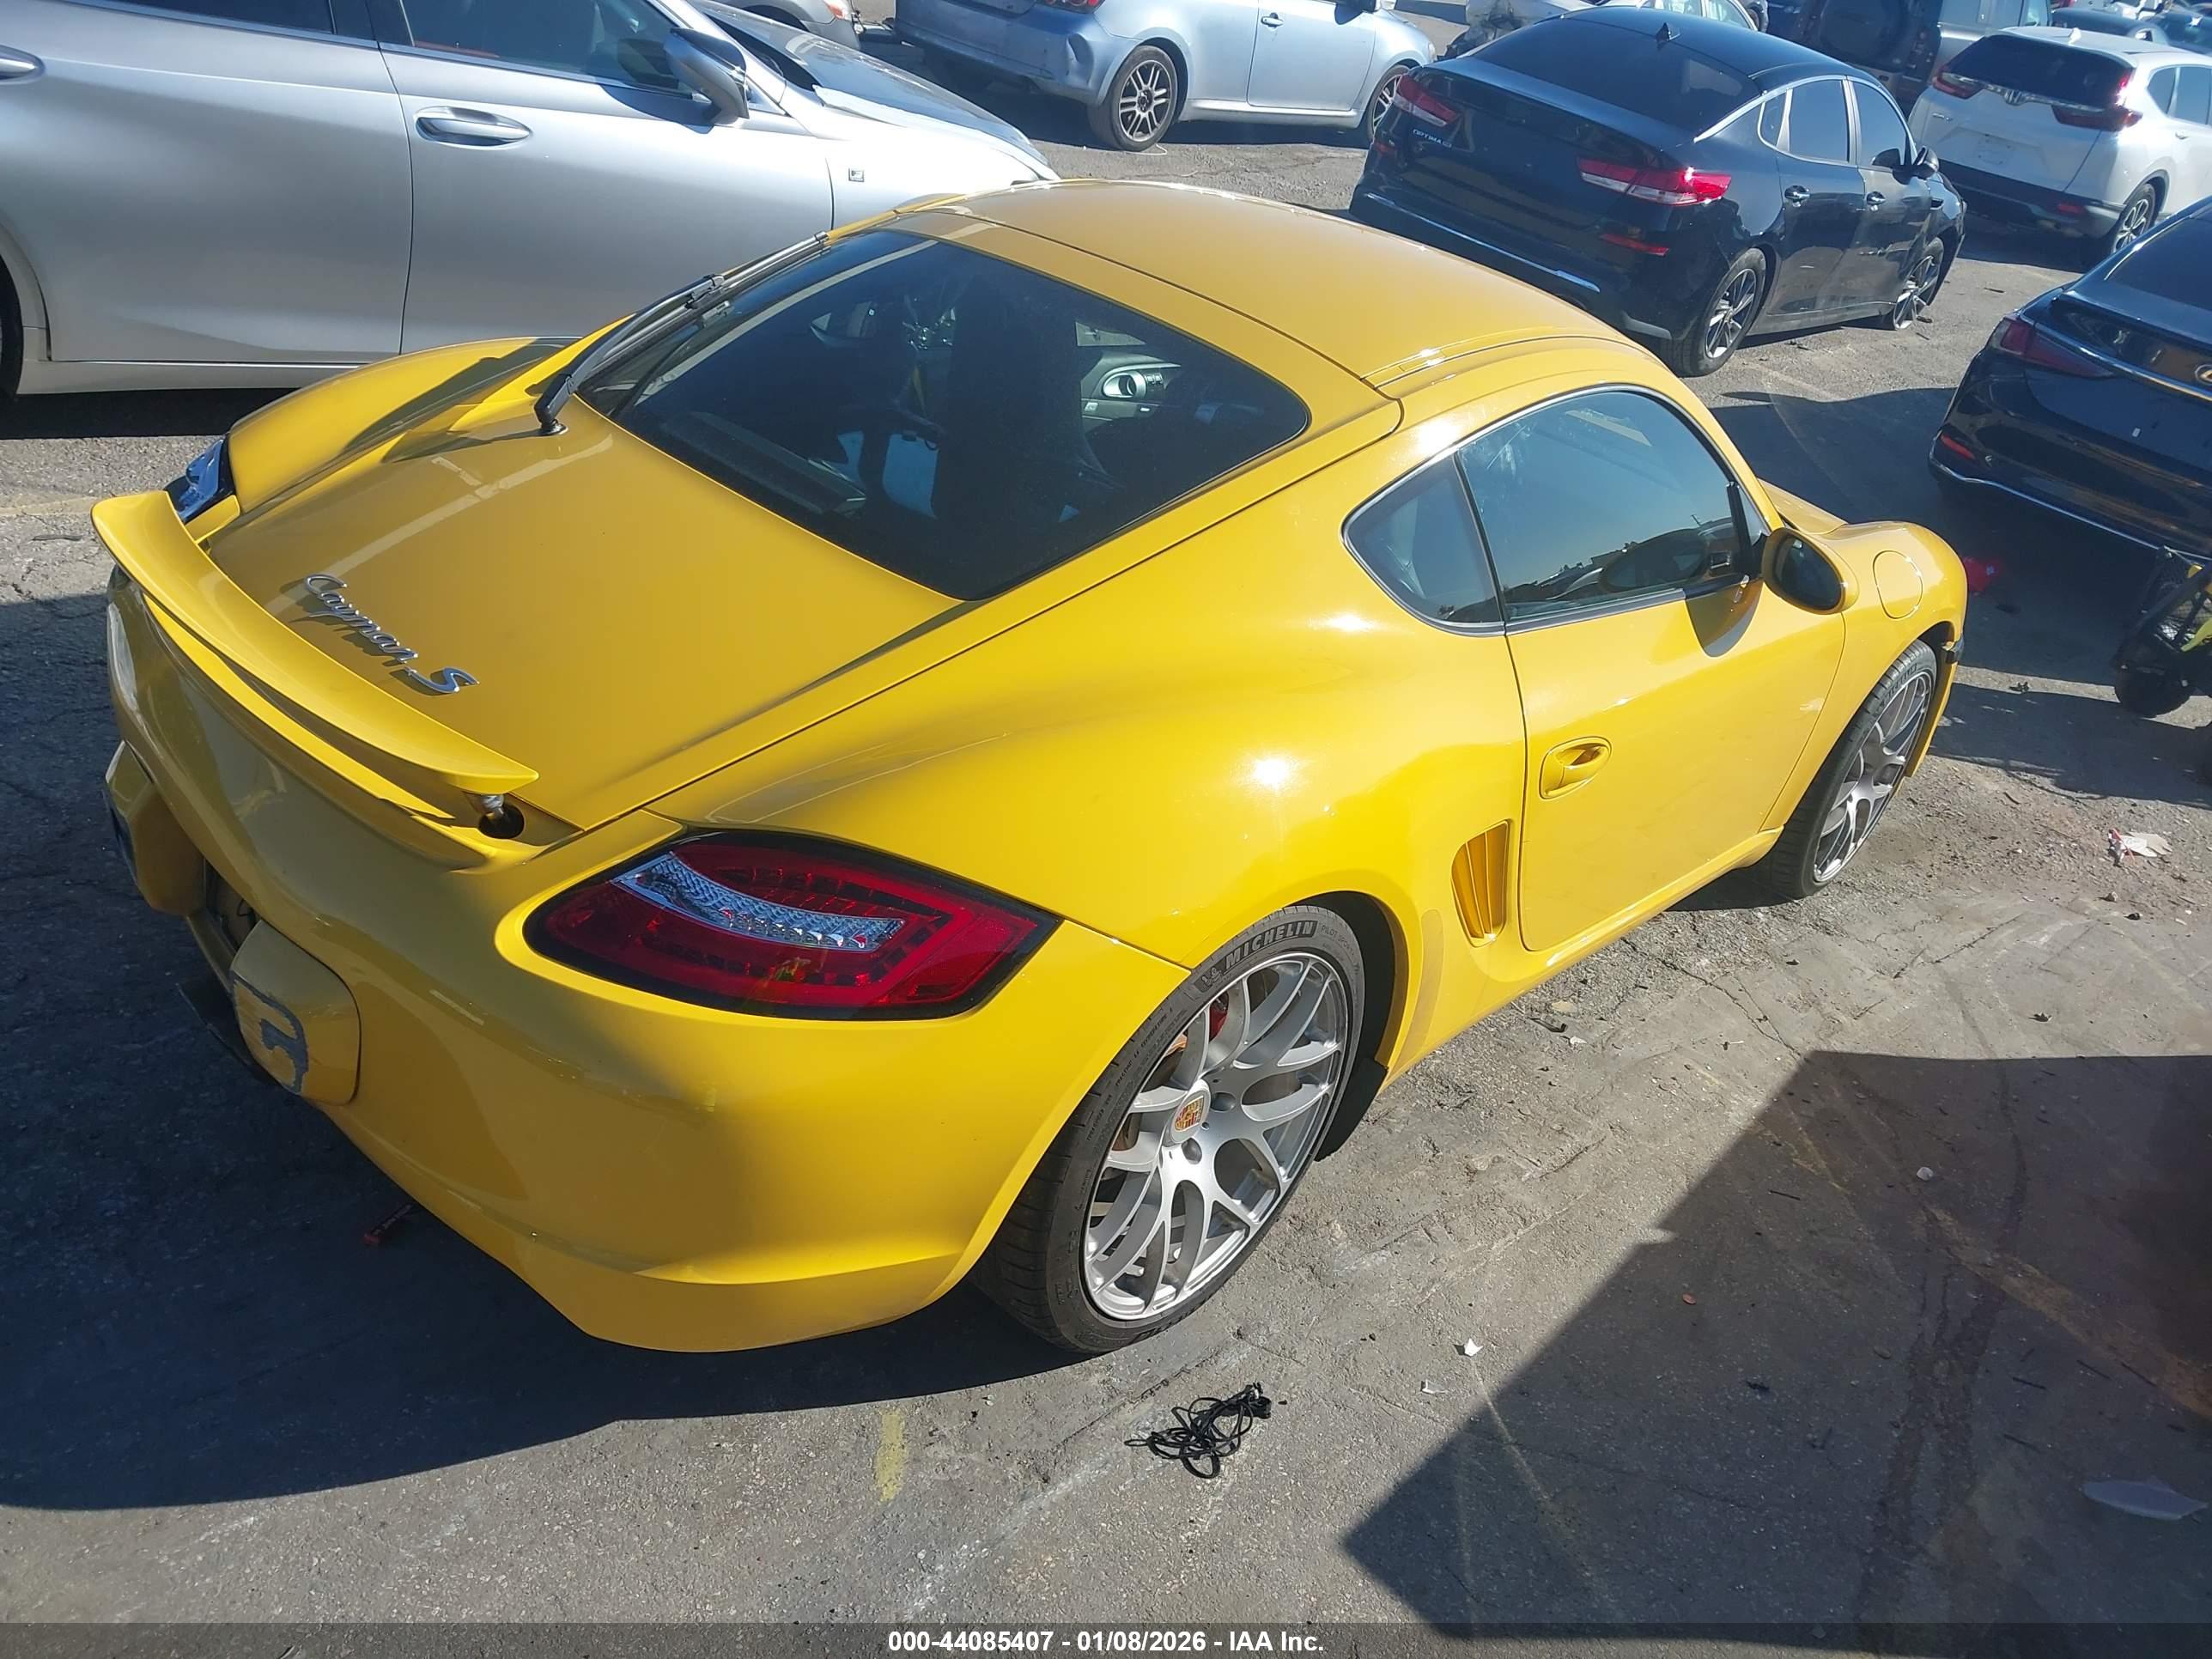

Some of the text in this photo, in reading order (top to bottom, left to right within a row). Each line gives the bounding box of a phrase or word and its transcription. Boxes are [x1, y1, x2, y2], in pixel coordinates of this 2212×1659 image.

[1413, 129, 1442, 144] OPTIMA
[304, 574, 481, 695] Cayman S
[1225, 921, 1315, 969] MICHELIN
